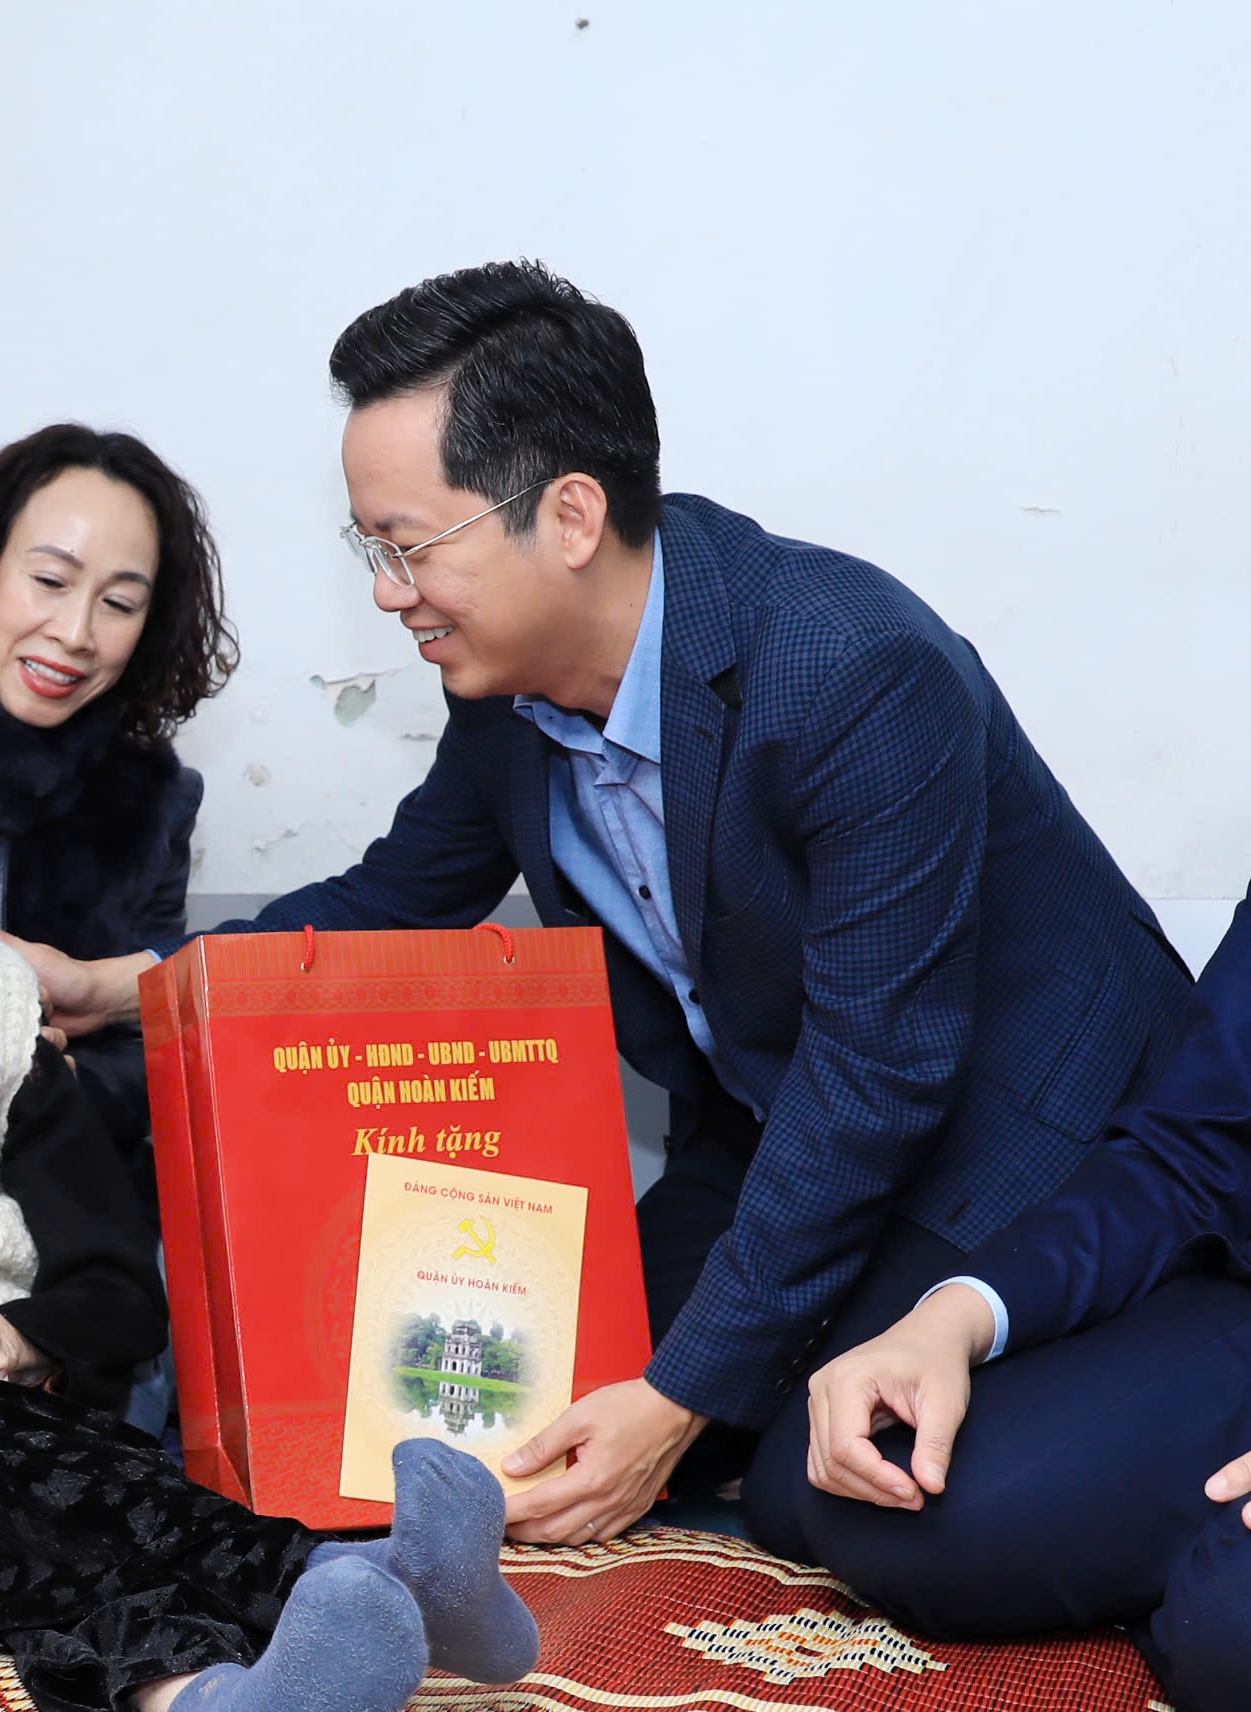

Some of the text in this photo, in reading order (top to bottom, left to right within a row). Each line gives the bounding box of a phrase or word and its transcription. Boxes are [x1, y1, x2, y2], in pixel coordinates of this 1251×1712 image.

[273, 1041, 323, 1075] QUẬN
[326, 1038, 350, 1069] ỦY
[365, 1043, 414, 1067] HĐND
[427, 1041, 475, 1065] UBND
[488, 1039, 559, 1064] UBMTTQ
[347, 1070, 495, 1109] QUẬN HOÀN KIẾM
[351, 1124, 502, 1159] Kính tặng
[440, 1186, 475, 1201] CỘNG
[478, 1192, 500, 1206] SẢN
[503, 1196, 525, 1212] VIỆT
[527, 1201, 553, 1215] NAM
[416, 1270, 448, 1285] QUẬN
[468, 1278, 499, 1292] HOÀN
[502, 1281, 527, 1296] KIẾM
